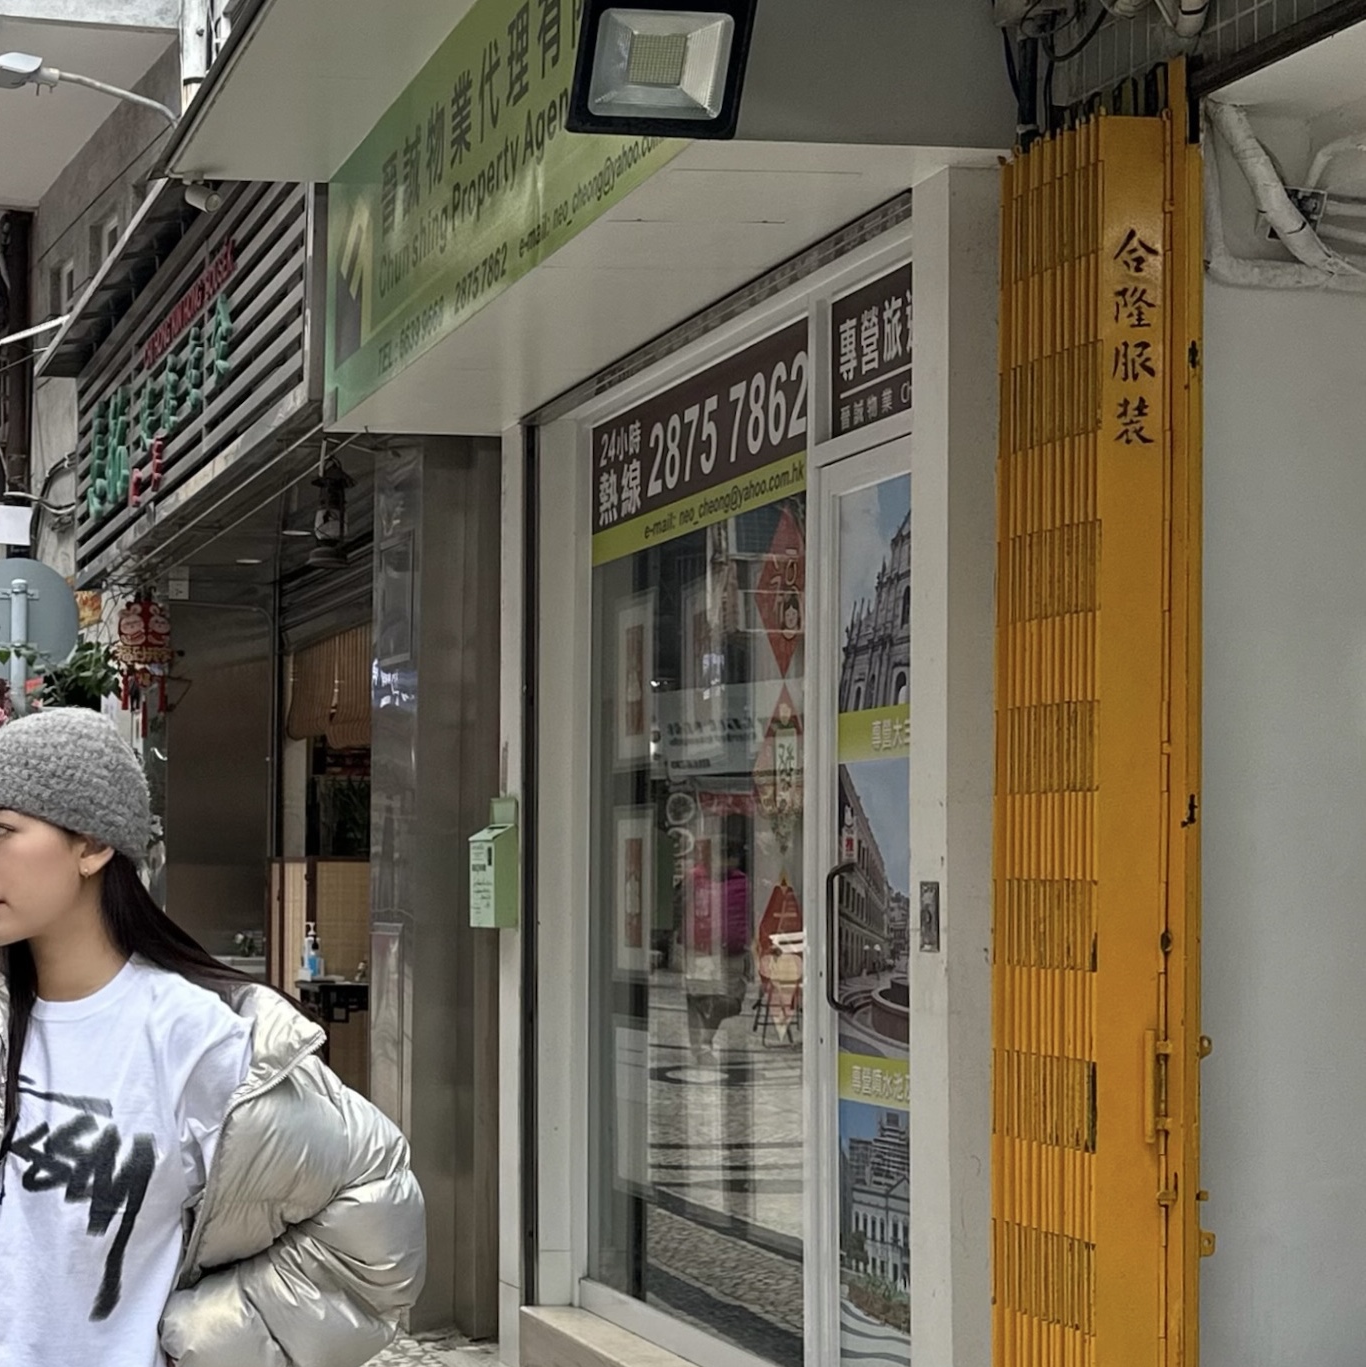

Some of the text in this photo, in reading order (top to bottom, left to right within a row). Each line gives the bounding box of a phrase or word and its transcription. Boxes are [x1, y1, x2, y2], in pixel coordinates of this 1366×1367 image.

[451, 135, 520, 232] Property
[522, 86, 570, 168] Agen
[1112, 228, 1160, 445] 合隆服裝
[599, 419, 642, 468] 24小時
[646, 350, 808, 498] 2875 7862
[598, 458, 642, 527] 熱線
[644, 460, 805, 540] e-mail: neo_cheong@yahoo.com.hk
